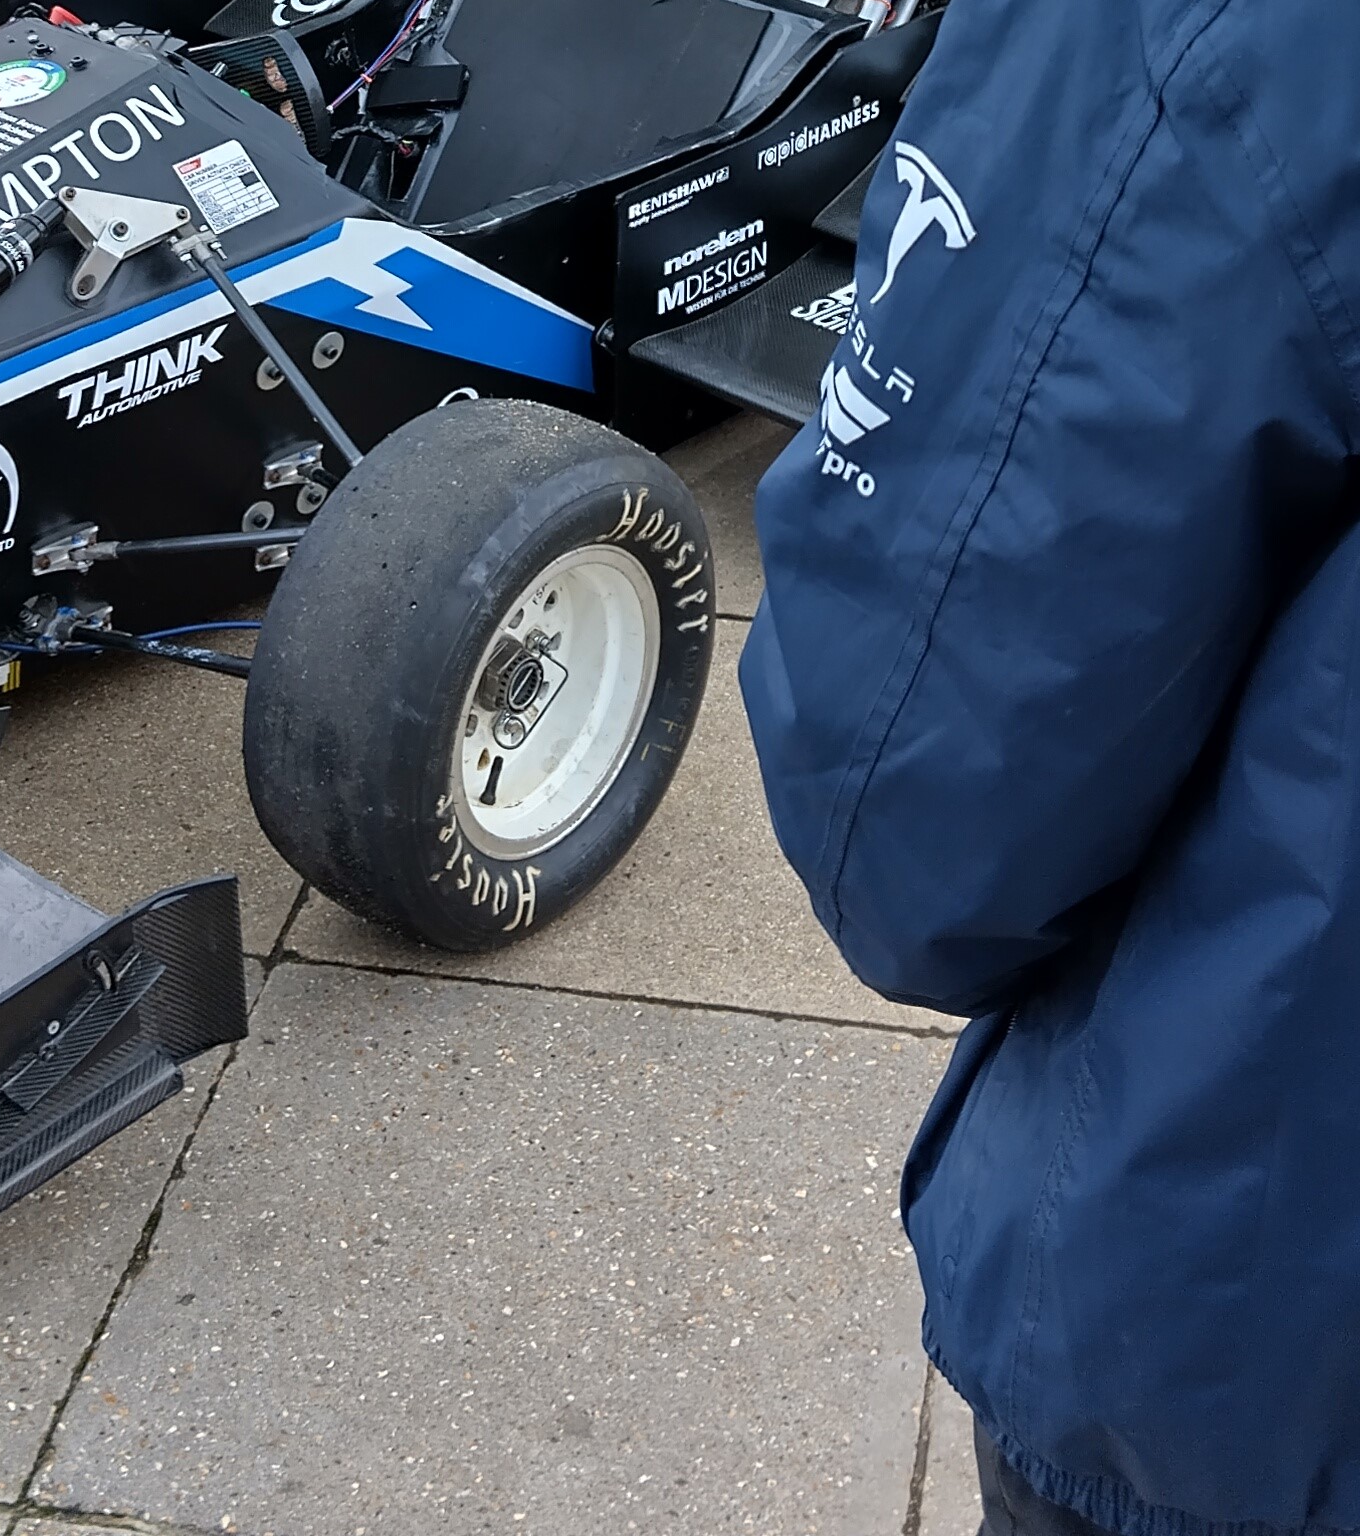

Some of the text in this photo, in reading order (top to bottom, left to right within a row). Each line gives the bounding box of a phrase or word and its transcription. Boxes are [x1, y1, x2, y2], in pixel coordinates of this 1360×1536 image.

[756, 100, 881, 172] rapidHARNESS
[628, 172, 717, 220] RENISHAW
[657, 240, 768, 315] MDESIGN
[663, 218, 765, 276] norelem
[57, 324, 228, 421] THINK
[76, 368, 202, 429] AUTOMOTIVE
